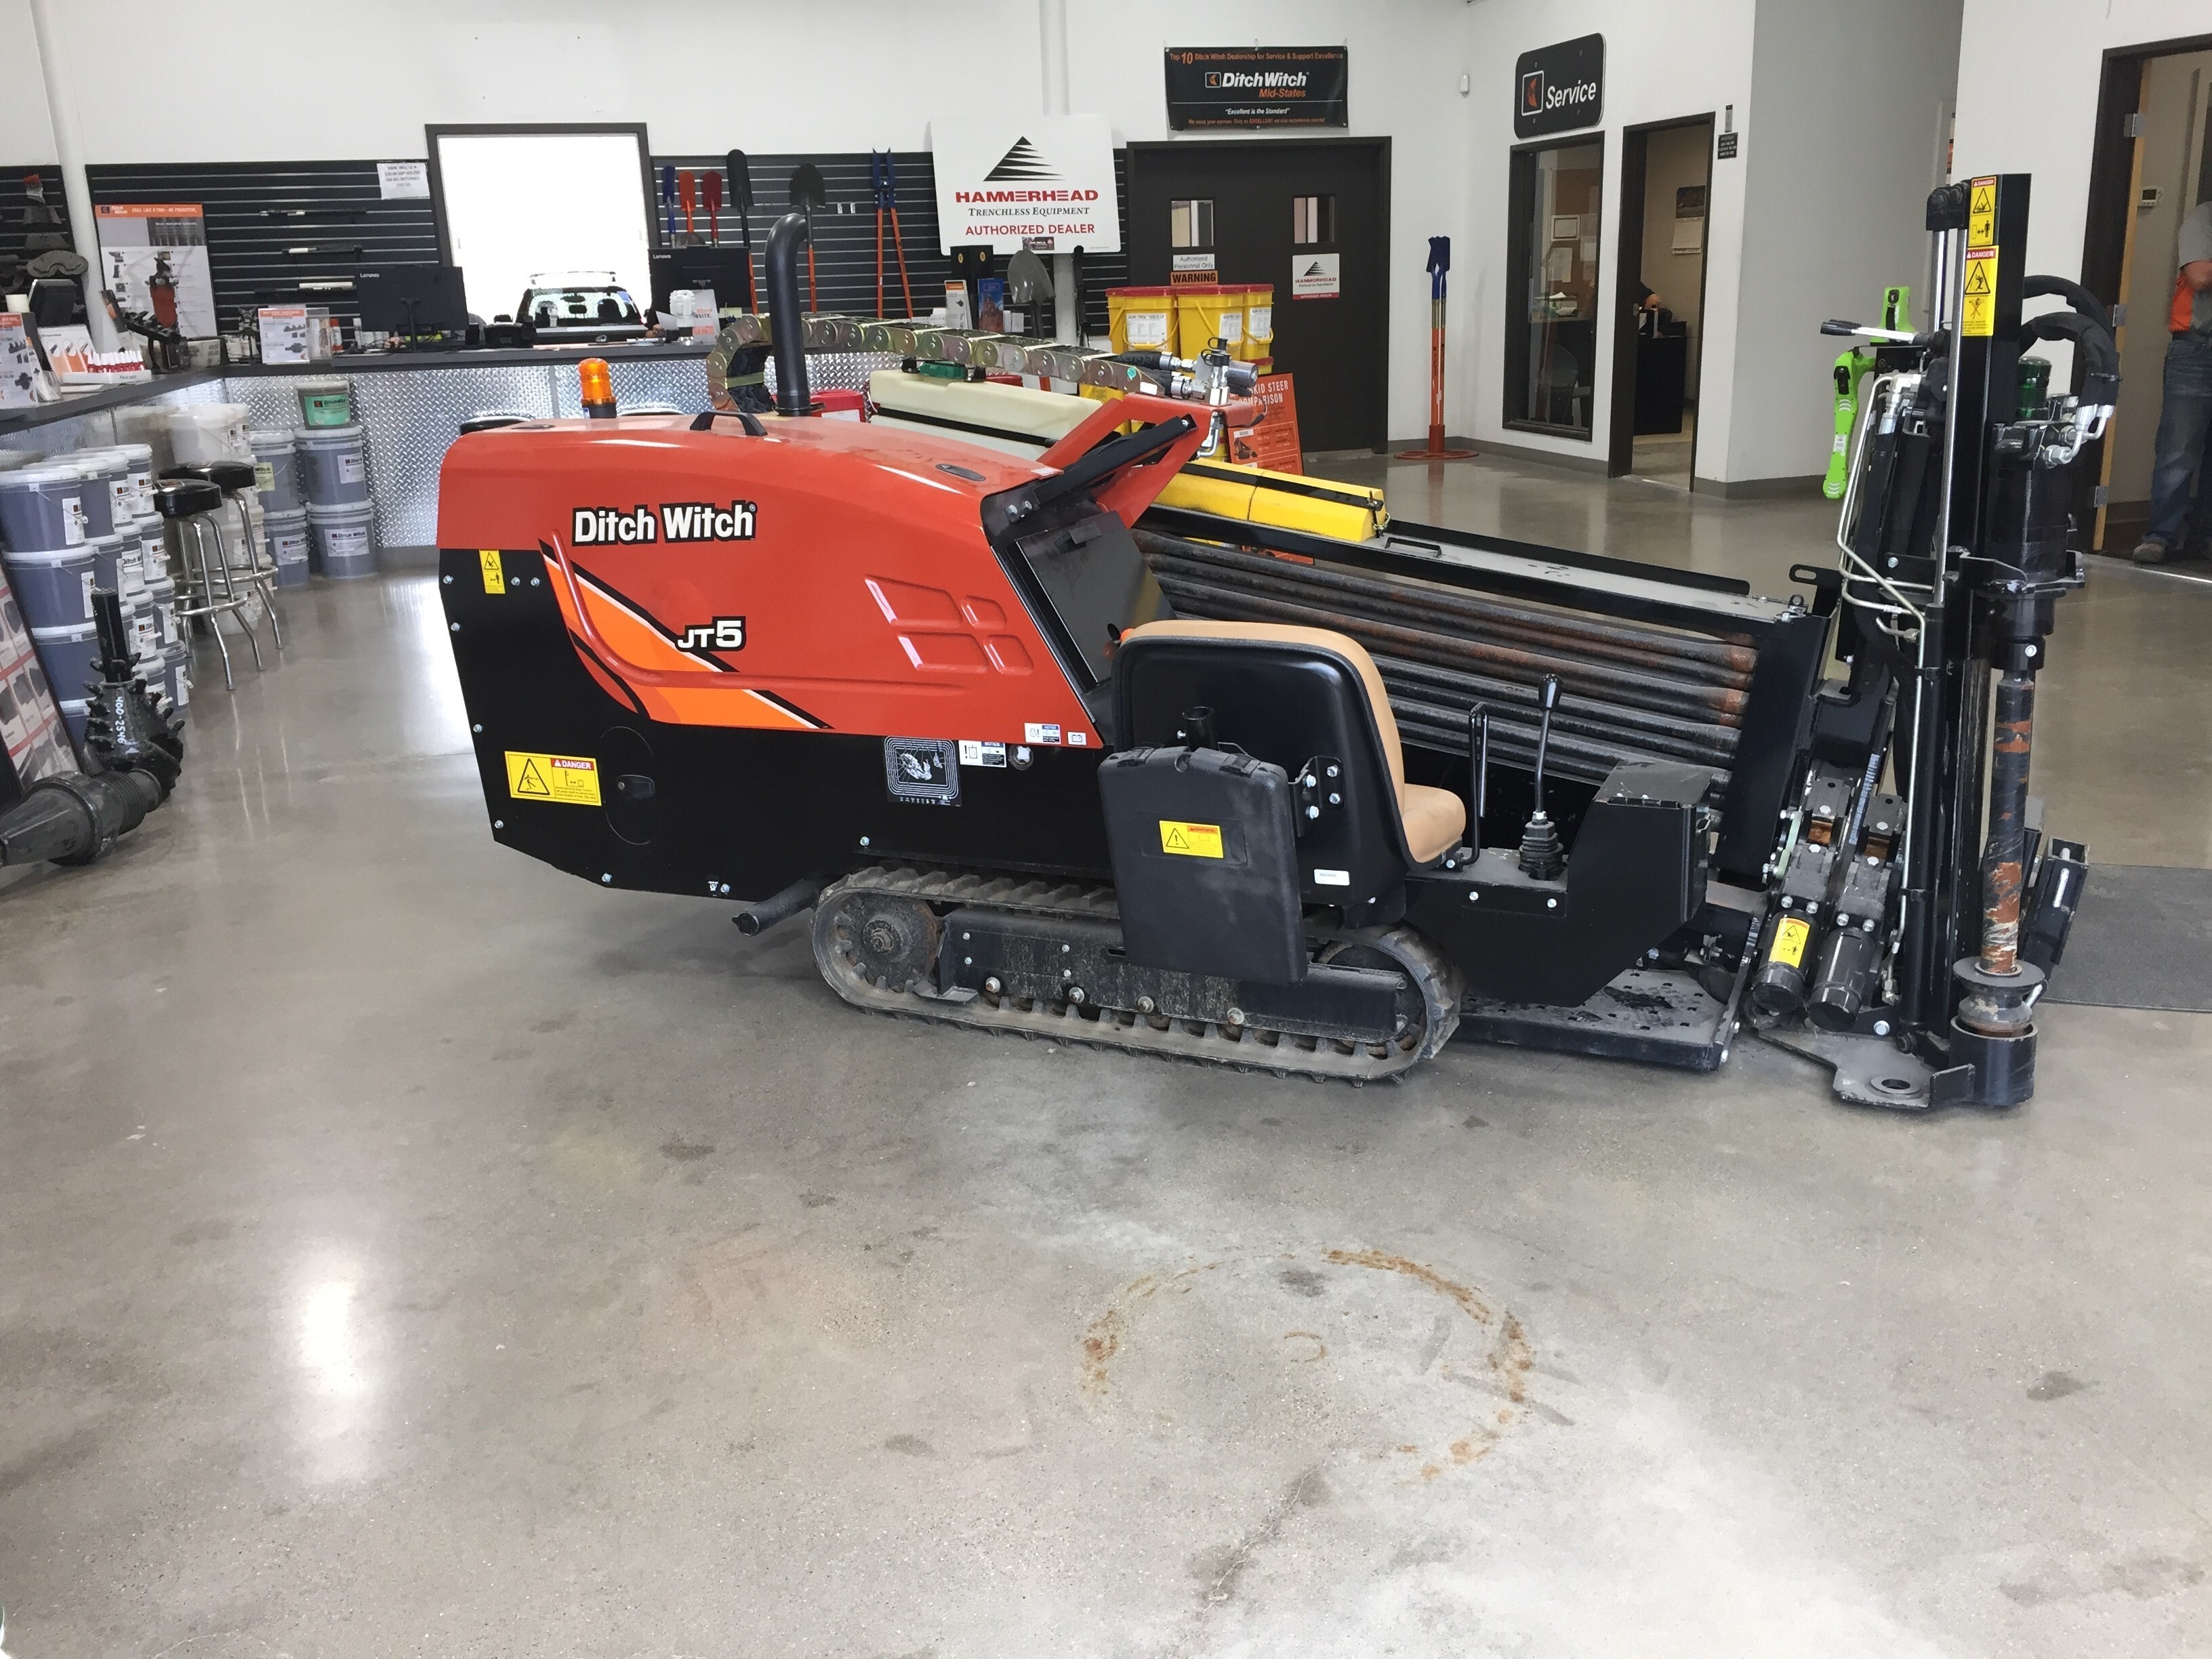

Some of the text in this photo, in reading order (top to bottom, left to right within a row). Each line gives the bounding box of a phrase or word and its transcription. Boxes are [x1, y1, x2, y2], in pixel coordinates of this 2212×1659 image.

[1181, 52, 1193, 64] 10
[1258, 88, 1307, 98] Mid-States
[1546, 79, 1597, 109] Service
[956, 190, 1099, 203] HAMMERHEAD
[968, 207, 1090, 217] TRENCHLESS EQUIPMENT
[966, 224, 1095, 235] AUTHORIZED DEALER
[1971, 250, 1994, 258] DANGER
[1172, 272, 1216, 283] WARNING
[1267, 380, 1288, 392] STEER
[1239, 393, 1283, 406] OMPARISON
[575, 504, 754, 543] Ditch Witch
[678, 619, 742, 649] JT5
[562, 761, 592, 770] DANGER
